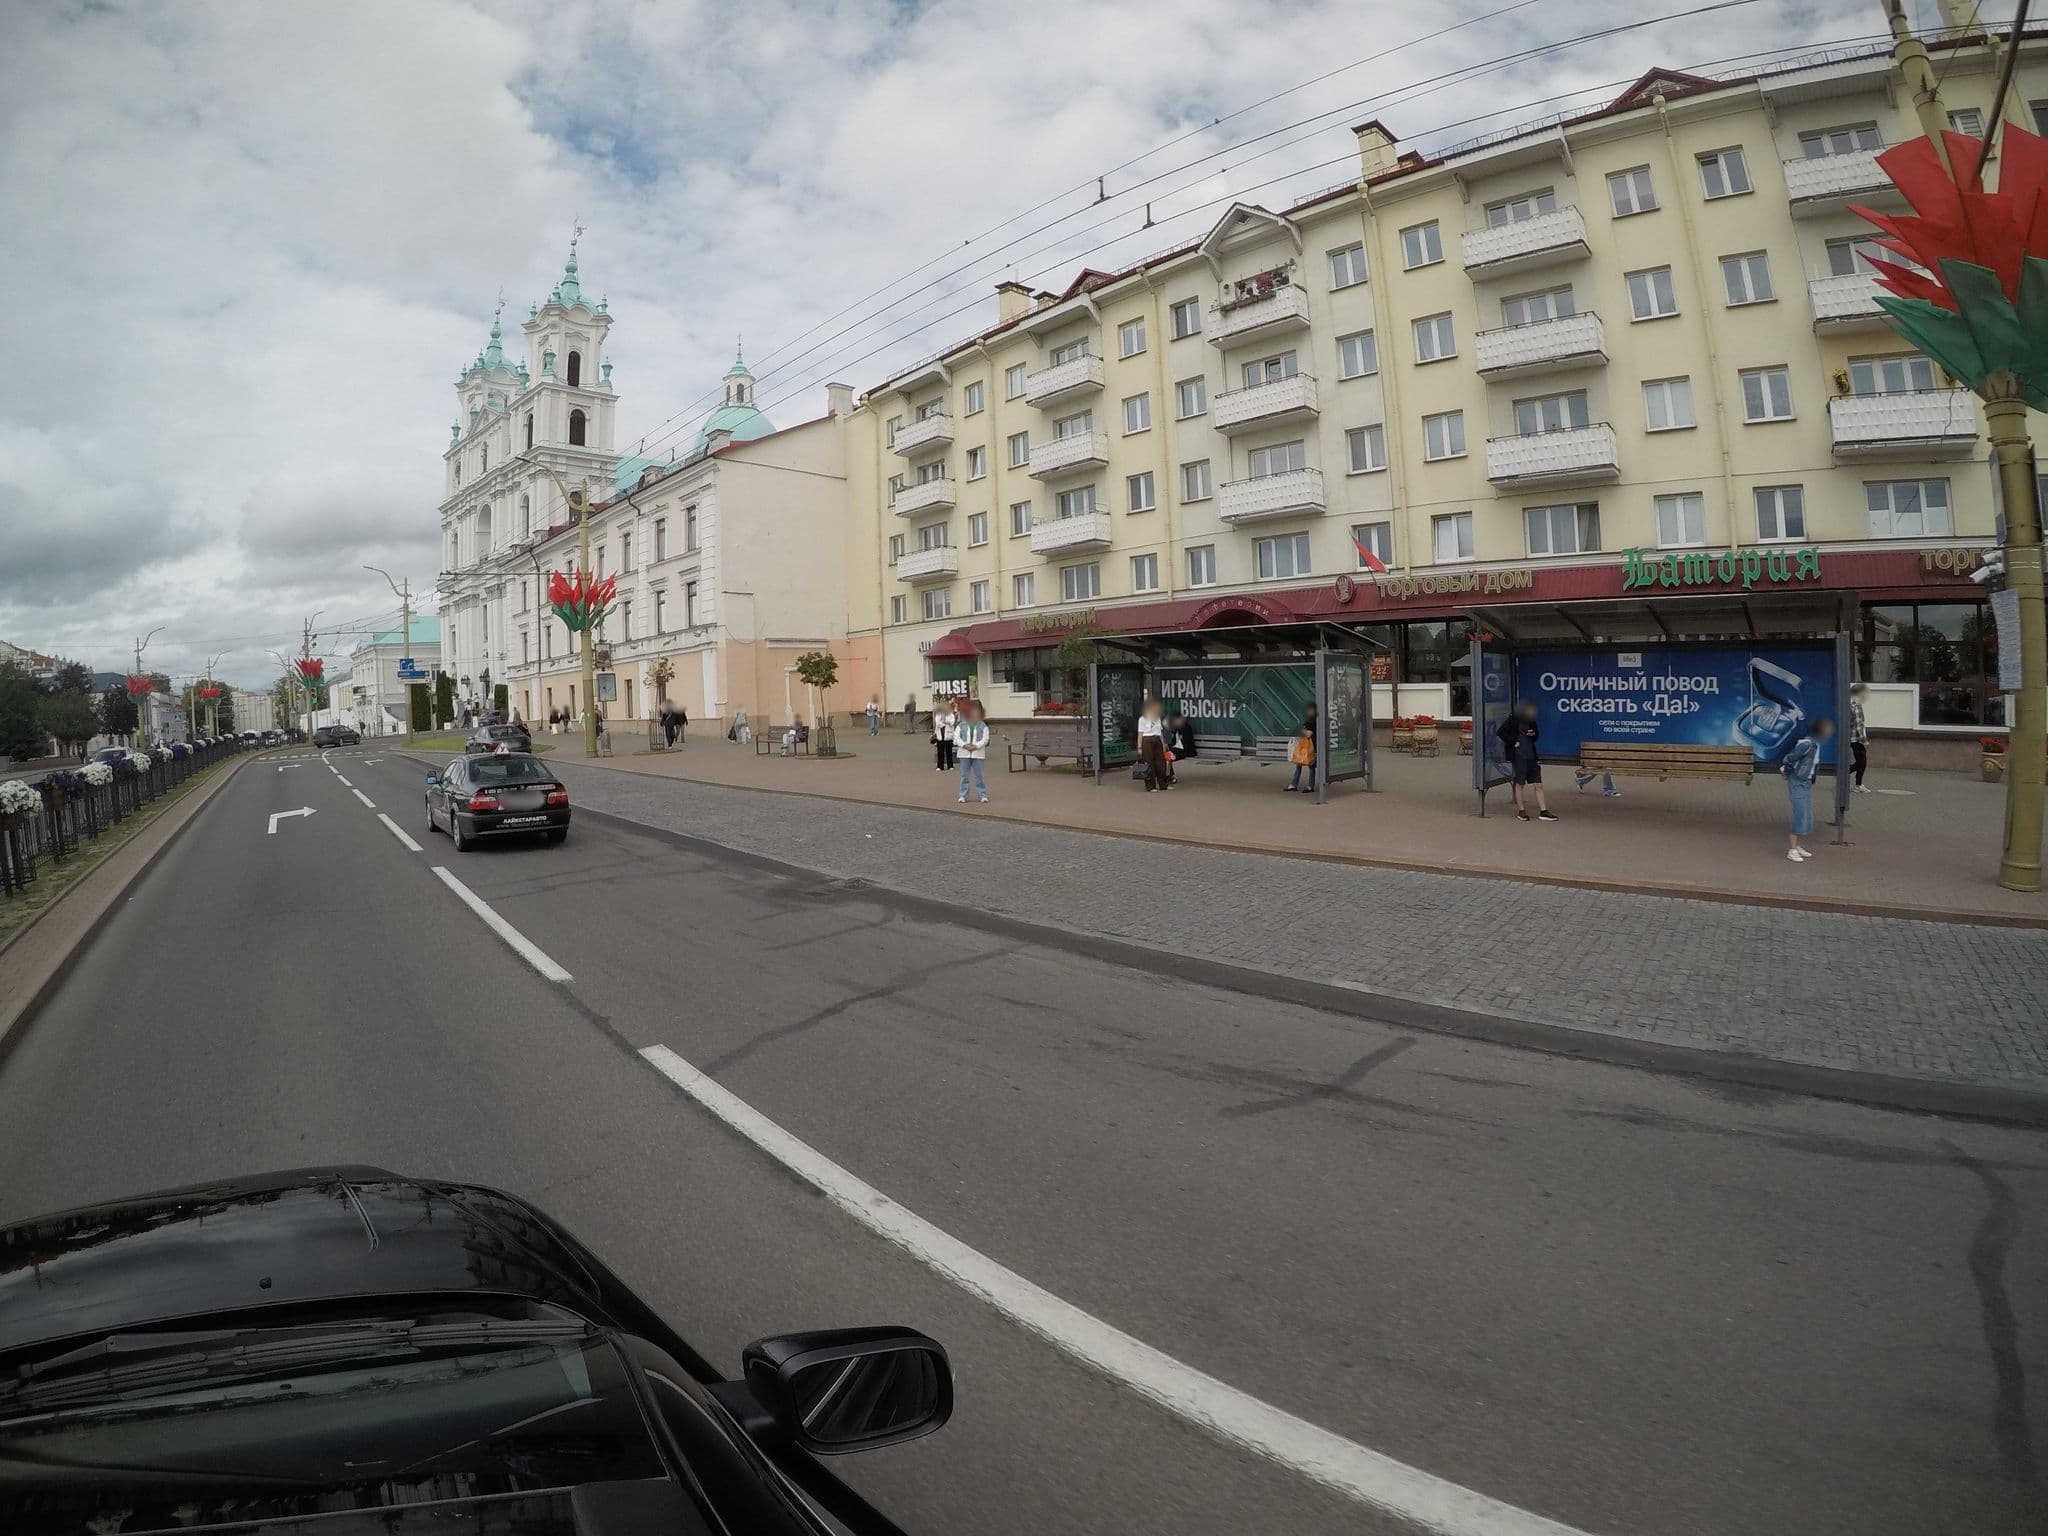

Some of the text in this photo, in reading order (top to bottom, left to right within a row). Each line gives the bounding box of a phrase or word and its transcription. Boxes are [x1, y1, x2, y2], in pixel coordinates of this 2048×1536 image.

[1161, 675, 1205, 698] ИГРАЙ
[1539, 671, 1720, 695] Отличный повод
[1180, 699, 1237, 718] ВЫСОТЕ
[1557, 694, 1700, 717] сказать «Да!»
[1102, 700, 1114, 742] ИГРАЙ
